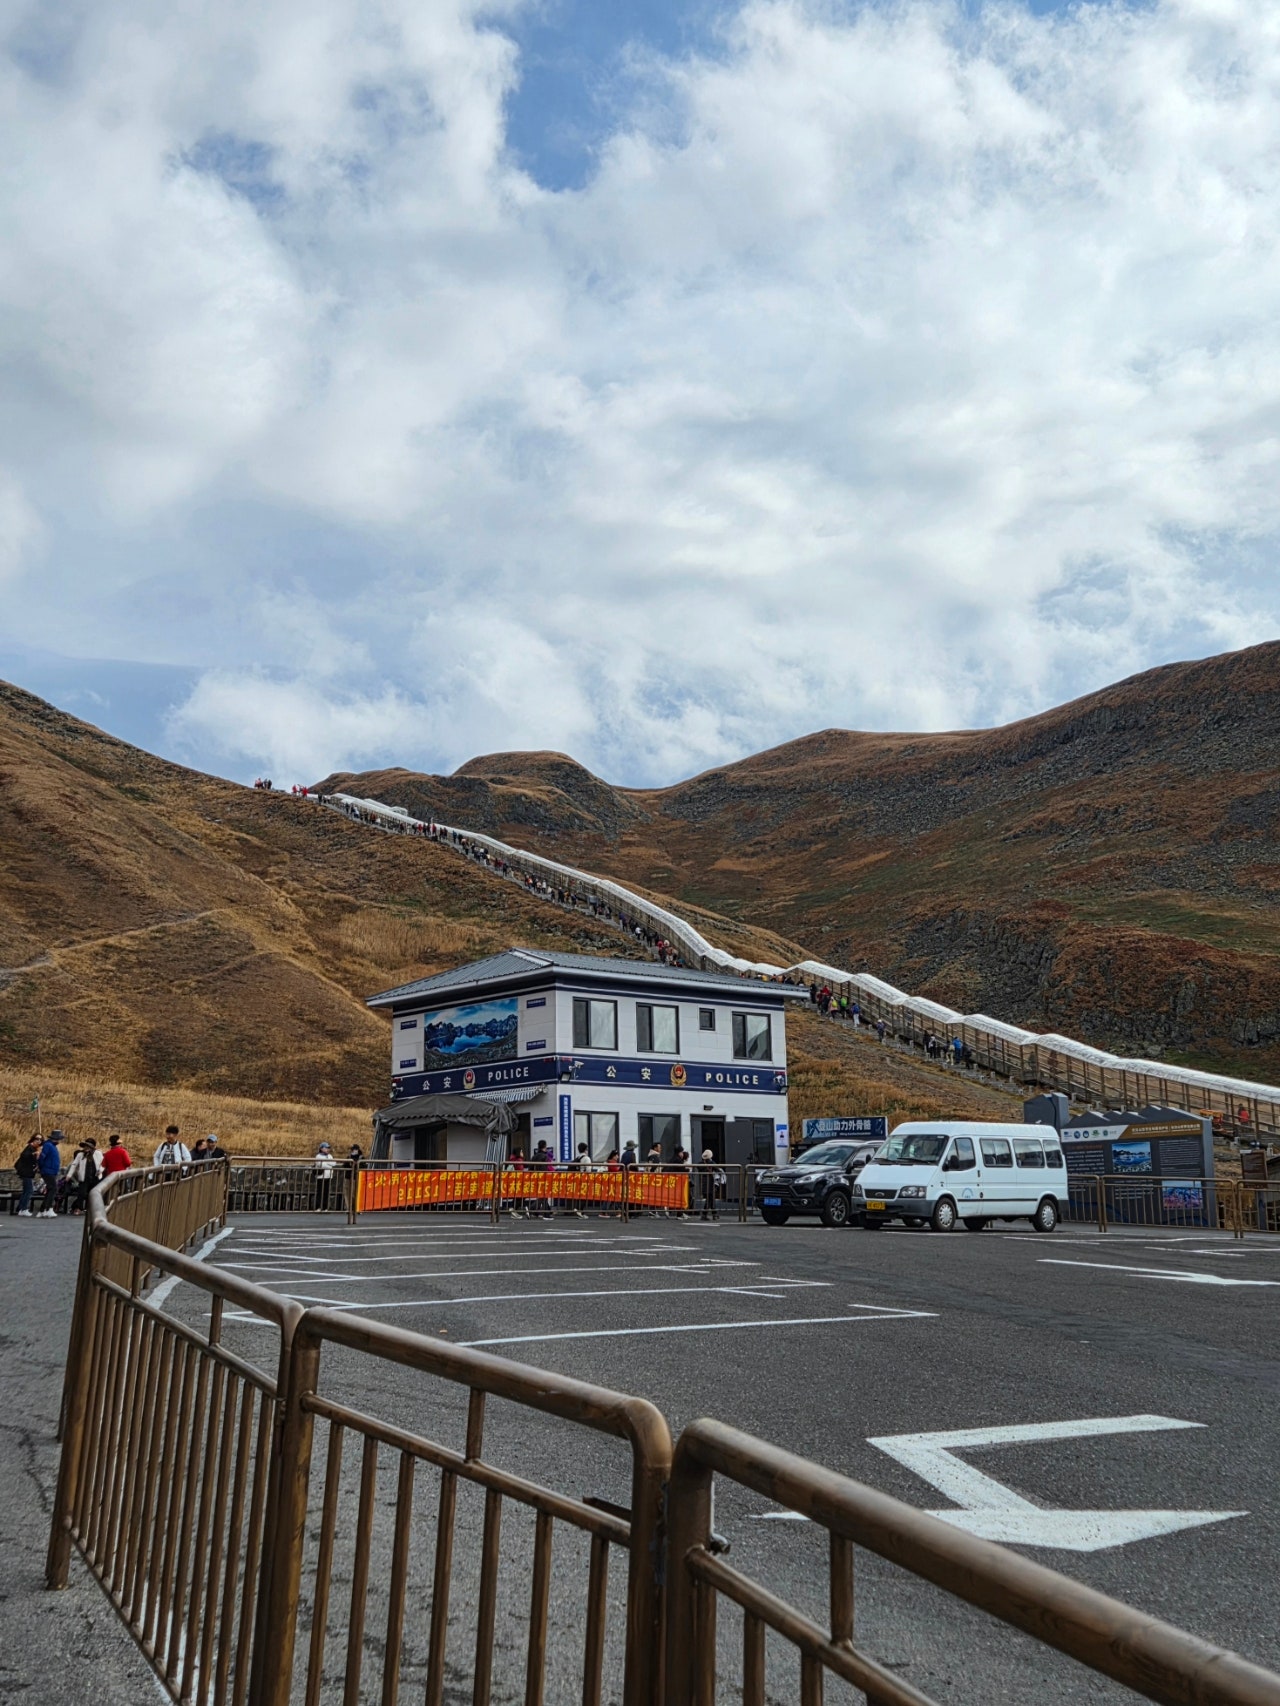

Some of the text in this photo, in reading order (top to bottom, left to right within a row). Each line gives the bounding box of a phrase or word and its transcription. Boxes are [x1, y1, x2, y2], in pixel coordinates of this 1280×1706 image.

[422, 1066, 529, 1091] 公安 POLICE
[606, 1065, 759, 1085] 公安 POLICE
